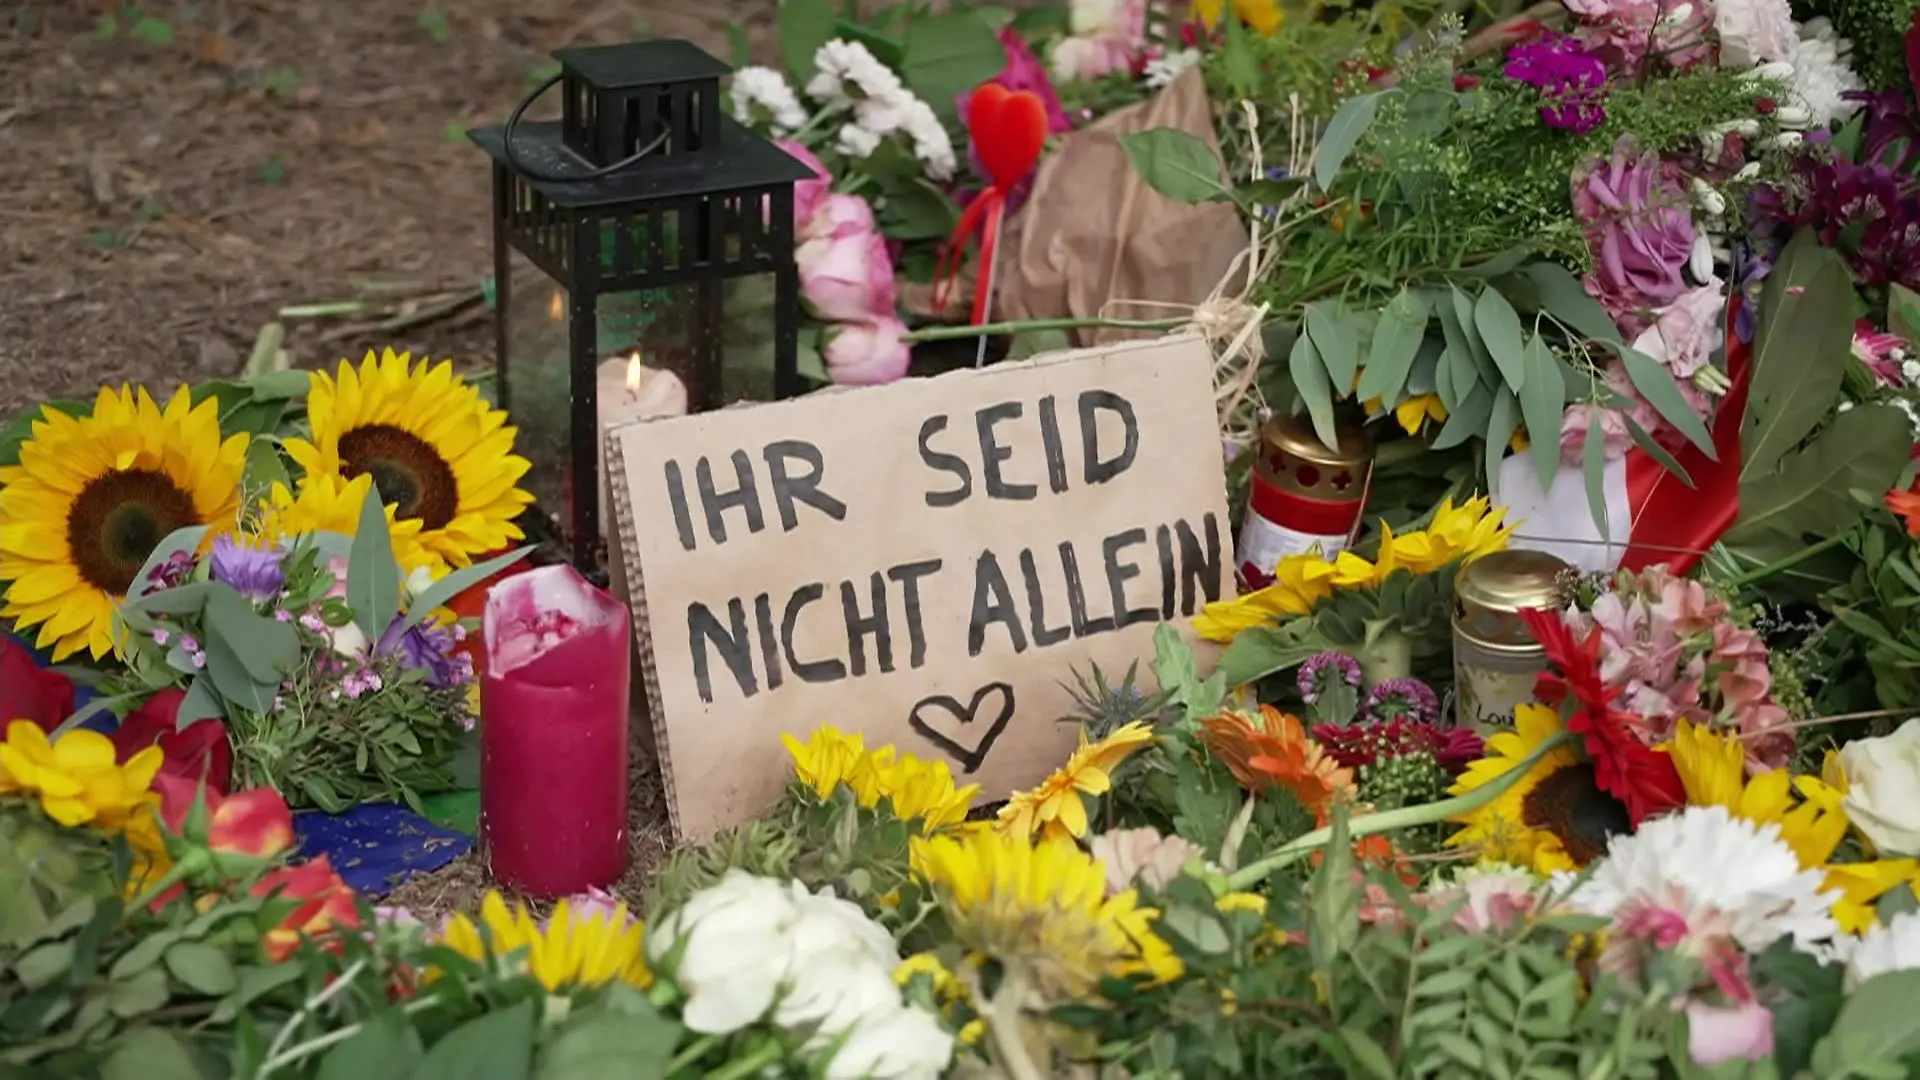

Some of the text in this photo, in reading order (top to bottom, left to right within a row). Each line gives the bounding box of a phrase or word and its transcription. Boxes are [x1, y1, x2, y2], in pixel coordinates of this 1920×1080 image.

[665, 390, 1139, 551] IHR SEID
[688, 512, 1221, 703] NICHT ALLEIN
